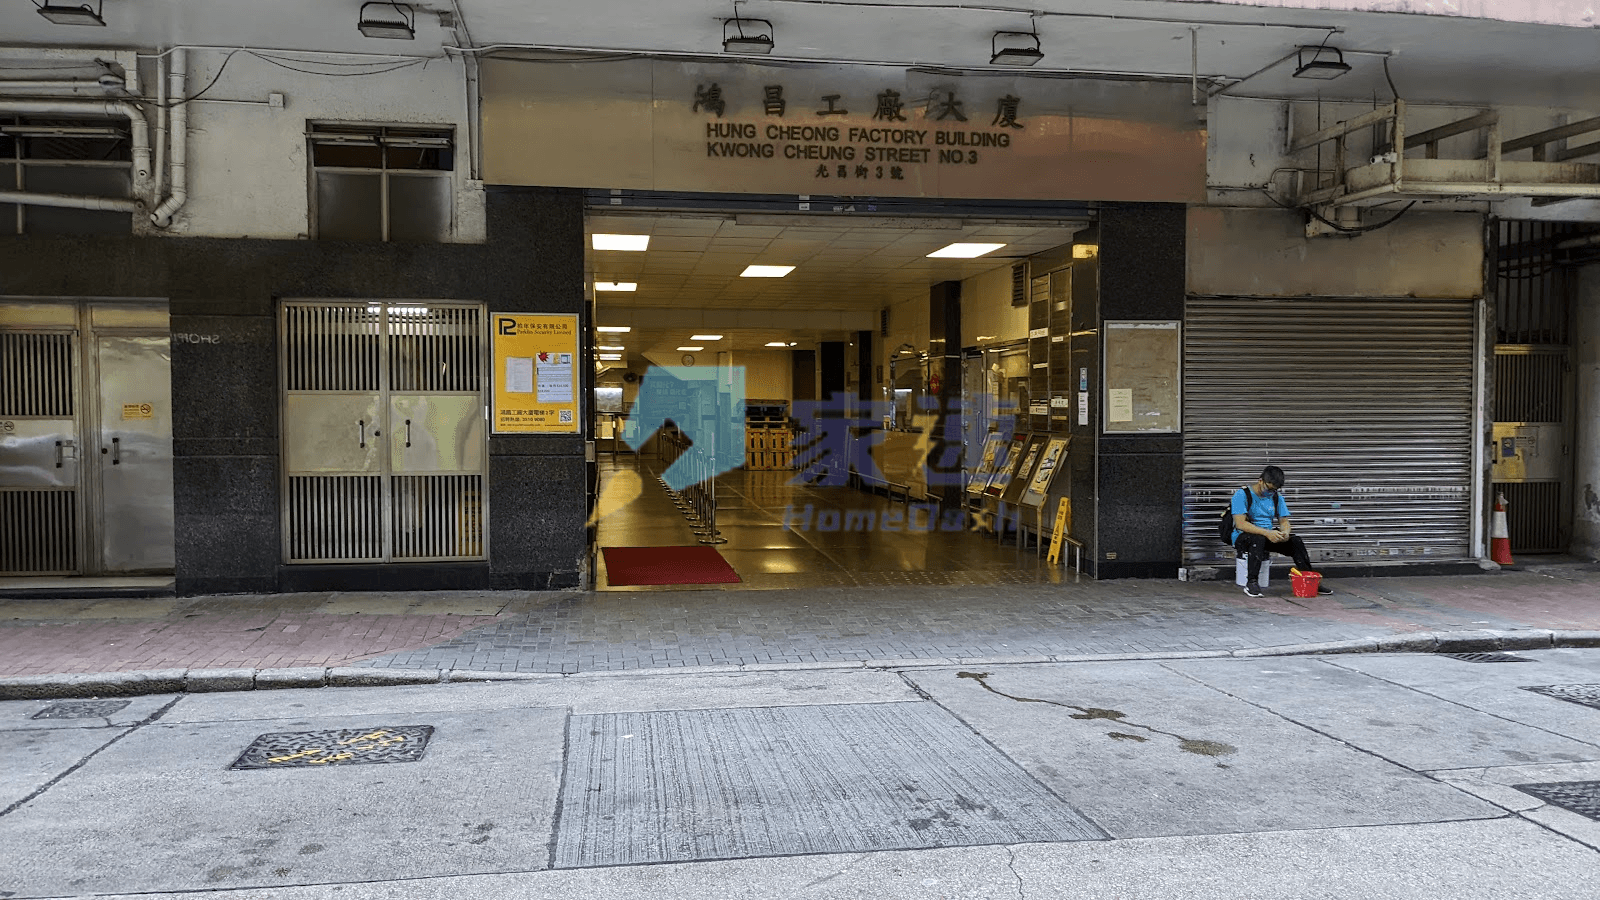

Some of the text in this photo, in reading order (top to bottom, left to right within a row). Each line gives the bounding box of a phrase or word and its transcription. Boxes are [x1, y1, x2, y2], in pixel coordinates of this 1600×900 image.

[693, 82, 1025, 130] 鴻昌工廠大廈
[706, 122, 1010, 148] HUNG CHEONG FACTORY BUILDING
[706, 141, 978, 165] KWONG CHEUNG STREET NO.3
